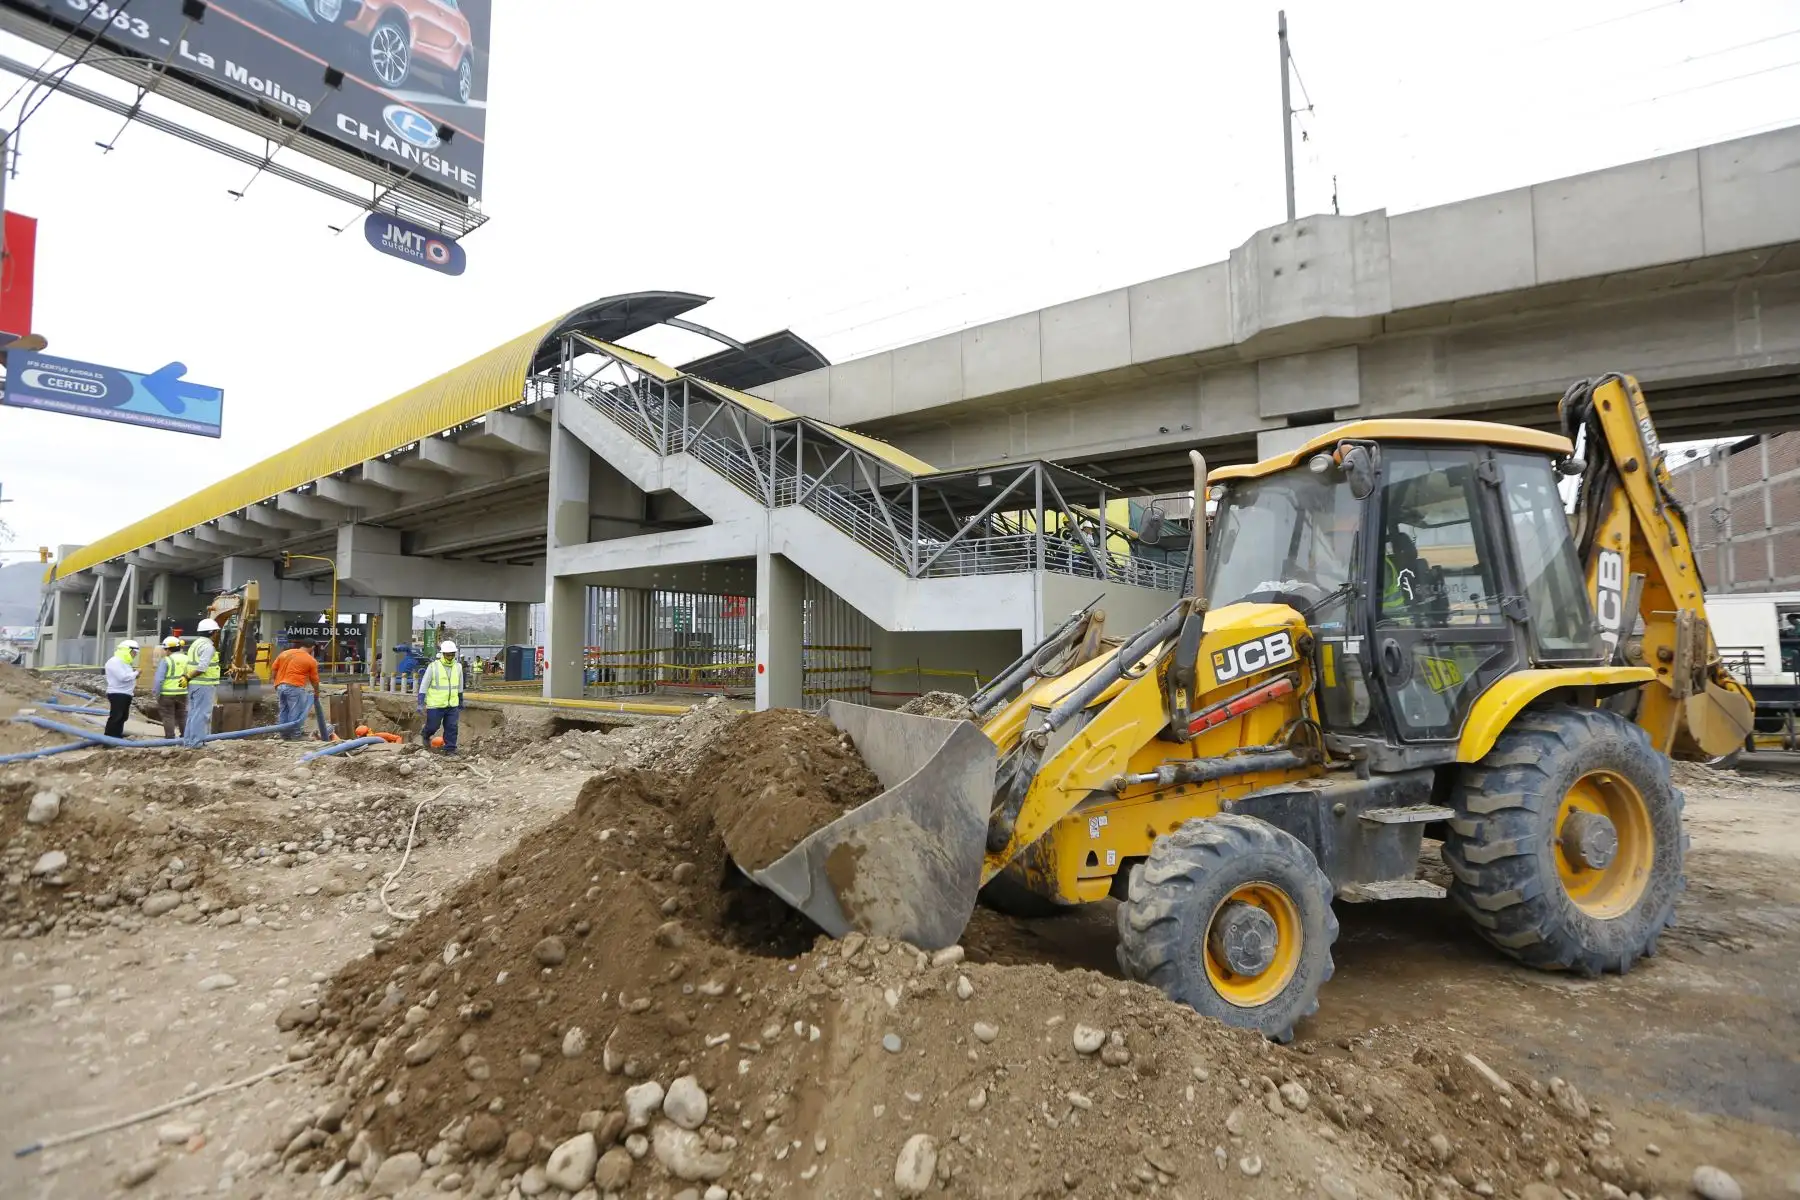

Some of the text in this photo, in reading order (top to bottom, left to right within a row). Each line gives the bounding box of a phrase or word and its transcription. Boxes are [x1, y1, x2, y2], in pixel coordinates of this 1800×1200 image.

[180, 39, 215, 70] La
[225, 60, 312, 115] Molina
[336, 112, 477, 190] CHANGHE
[382, 223, 426, 252] JMT
[382, 239, 424, 260] outdoors
[40, 362, 69, 373] CERTUS
[47, 377, 98, 394] CERTUS
[284, 625, 361, 636] ÁMIDE DEL SOL
[1216, 632, 1293, 681] JCB
[1425, 659, 1463, 690] JCB
